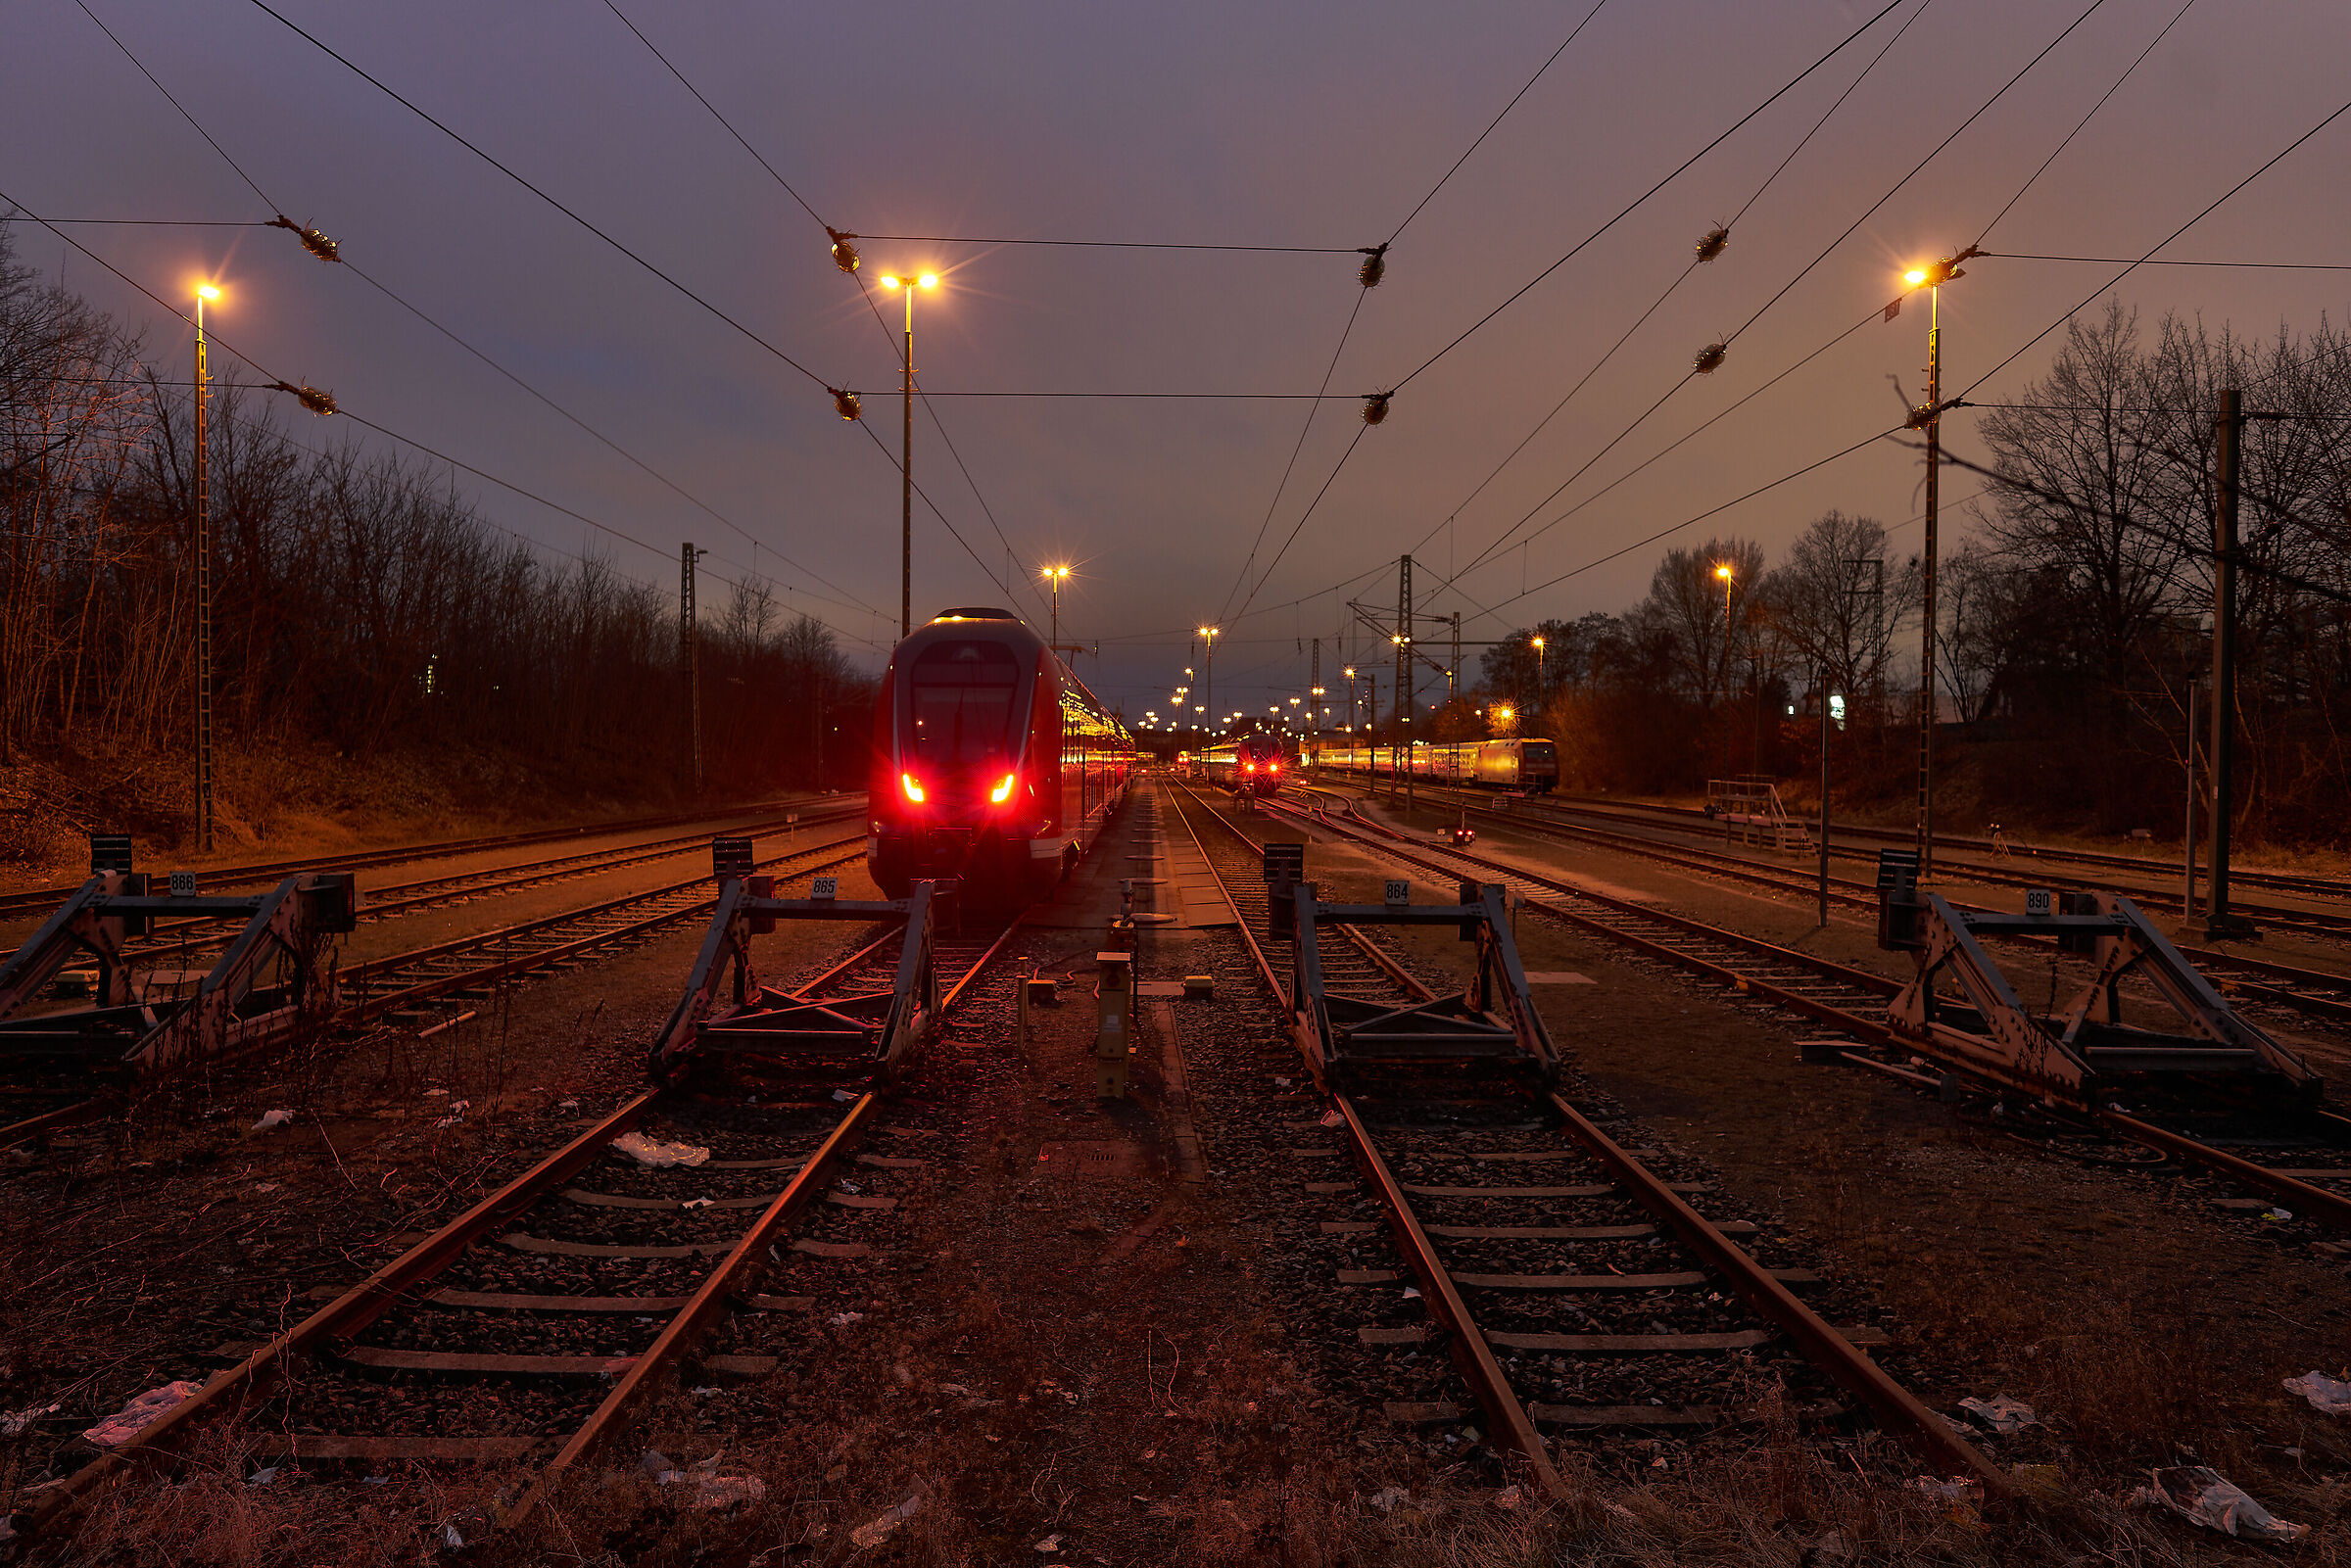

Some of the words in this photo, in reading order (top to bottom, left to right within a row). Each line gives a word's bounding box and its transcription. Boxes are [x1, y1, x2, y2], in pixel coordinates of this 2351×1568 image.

[171, 875, 193, 890] 866
[813, 879, 836, 893] 865
[1386, 883, 1408, 899] 864
[2028, 892, 2049, 908] 890
